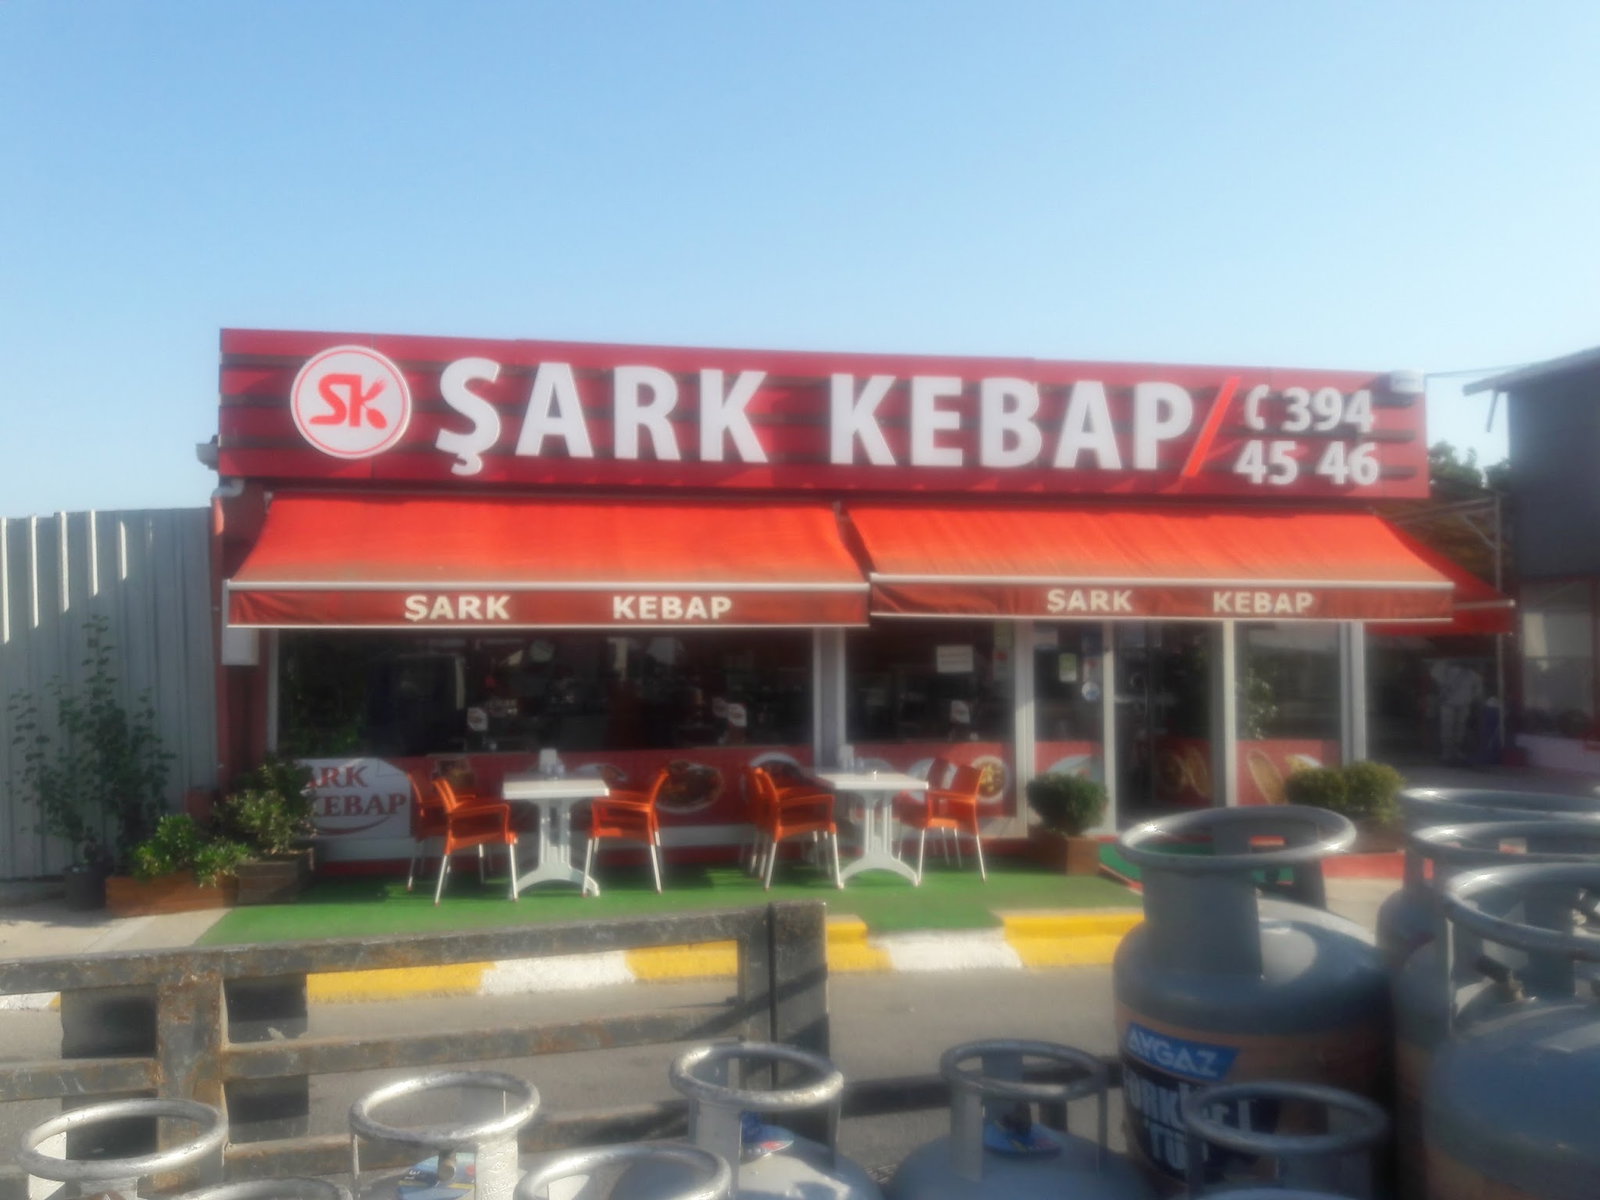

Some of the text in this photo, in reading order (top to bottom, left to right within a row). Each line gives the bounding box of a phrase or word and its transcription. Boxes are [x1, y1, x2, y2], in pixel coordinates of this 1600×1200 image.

[309, 373, 388, 430] SK
[436, 357, 1194, 476] ŞARK KEBAP
[1281, 386, 1375, 433] 394
[1234, 439, 1379, 485] 45 46
[404, 595, 732, 621] ŞARK KEBAP
[1212, 591, 1314, 614] KEBAP
[1129, 1030, 1218, 1078] AYGAZ
